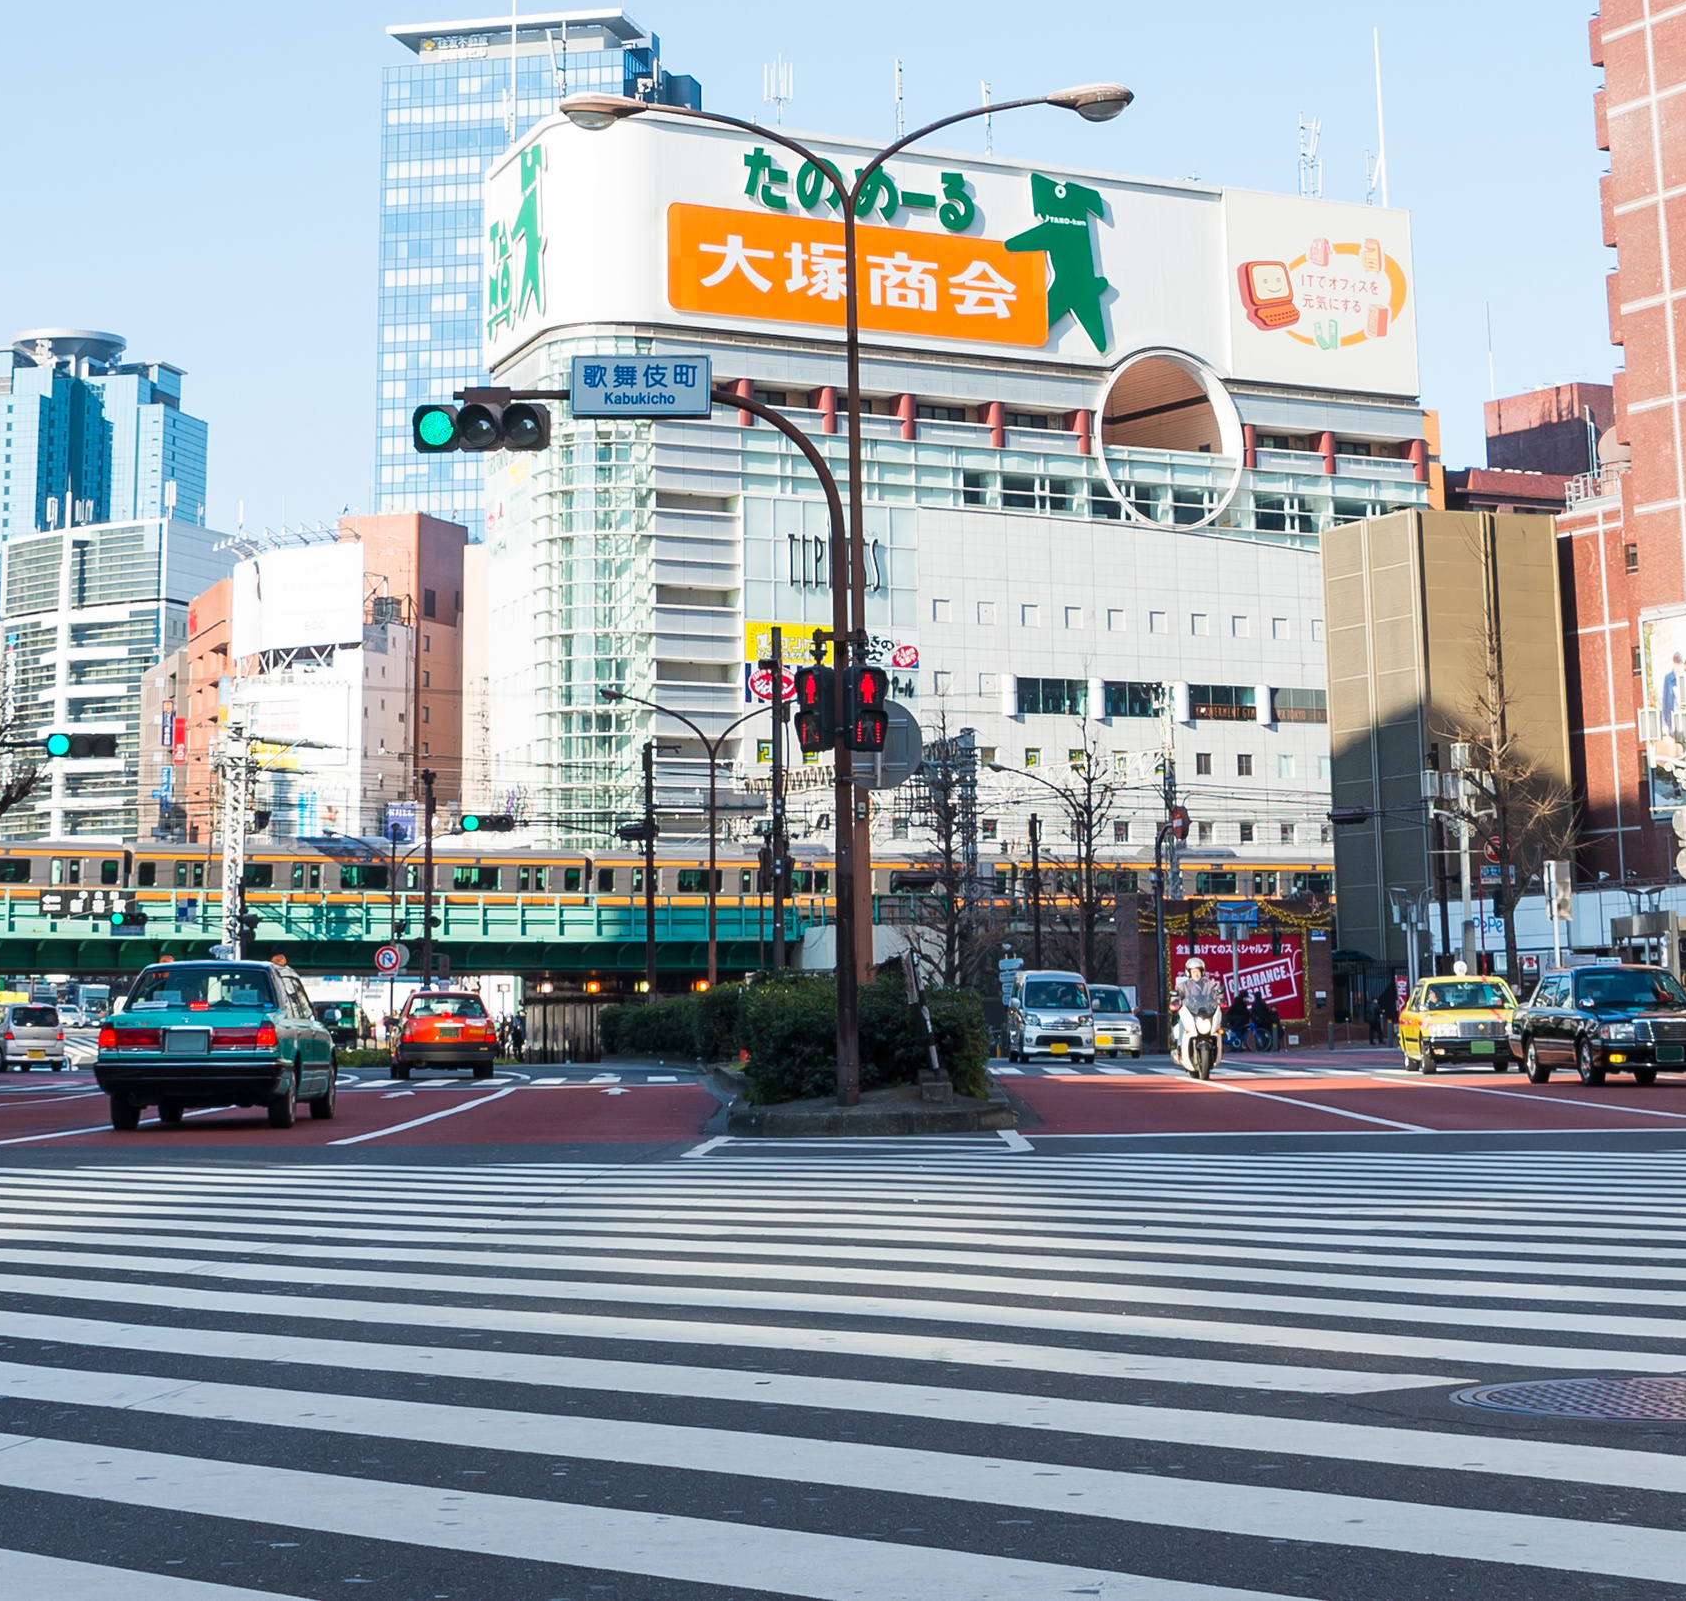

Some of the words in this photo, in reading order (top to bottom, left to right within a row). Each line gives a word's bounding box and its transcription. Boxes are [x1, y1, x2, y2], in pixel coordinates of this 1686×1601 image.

[744, 147, 976, 232] たのめーる
[699, 235, 1017, 319] 大塚商会
[1301, 272, 1379, 295] ITでオフィスを
[1303, 295, 1362, 313] 元気にする
[583, 364, 698, 389] 歌舞伎町
[604, 392, 676, 407] Kabukicho
